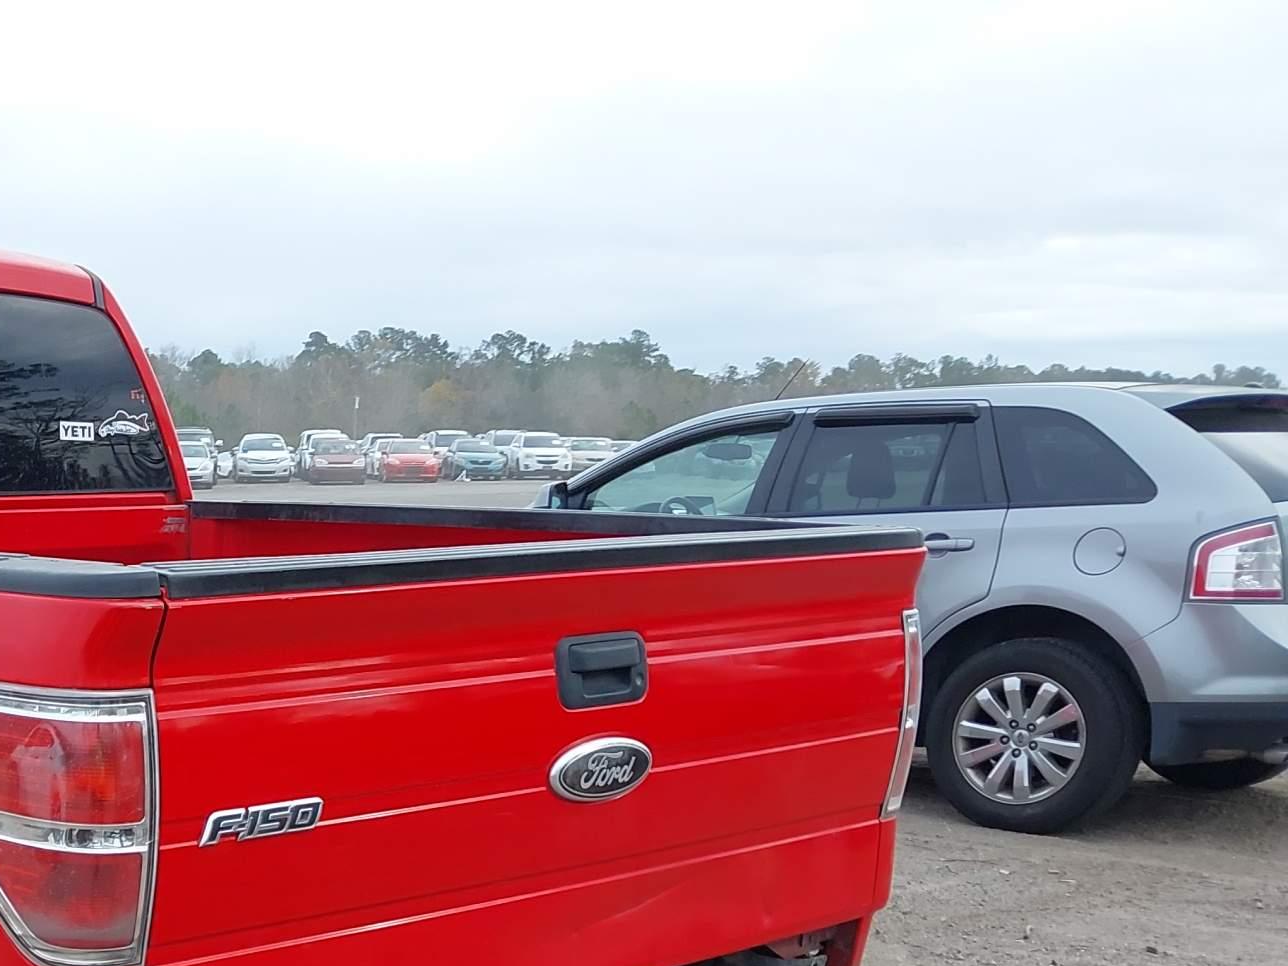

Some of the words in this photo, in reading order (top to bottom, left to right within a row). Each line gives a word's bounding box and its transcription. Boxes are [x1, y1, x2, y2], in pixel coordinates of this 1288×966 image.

[61, 423, 92, 438] YETI
[579, 749, 637, 791] Ford
[199, 796, 325, 849] F-150
